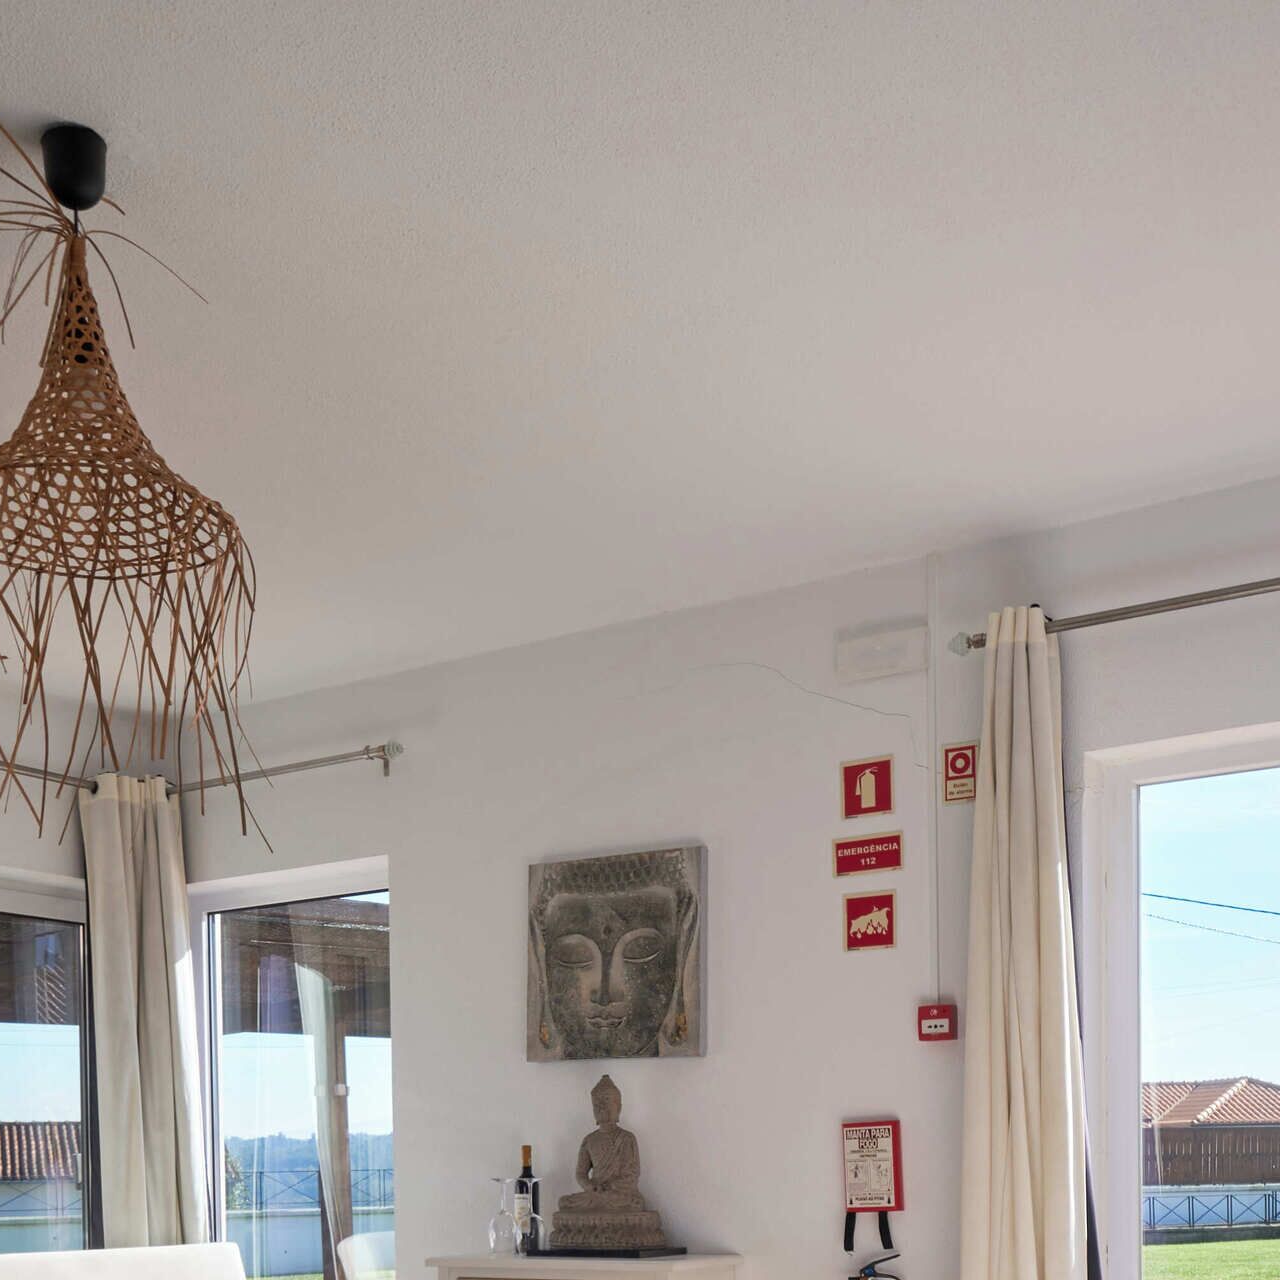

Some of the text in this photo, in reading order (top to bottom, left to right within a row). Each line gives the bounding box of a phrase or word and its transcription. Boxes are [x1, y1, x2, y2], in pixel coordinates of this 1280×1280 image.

[838, 842, 899, 857] EMERGÊNCIA
[860, 857, 877, 866] 112
[846, 1128, 890, 1139] MANTA PARA
[859, 1138, 878, 1149] FOGO
